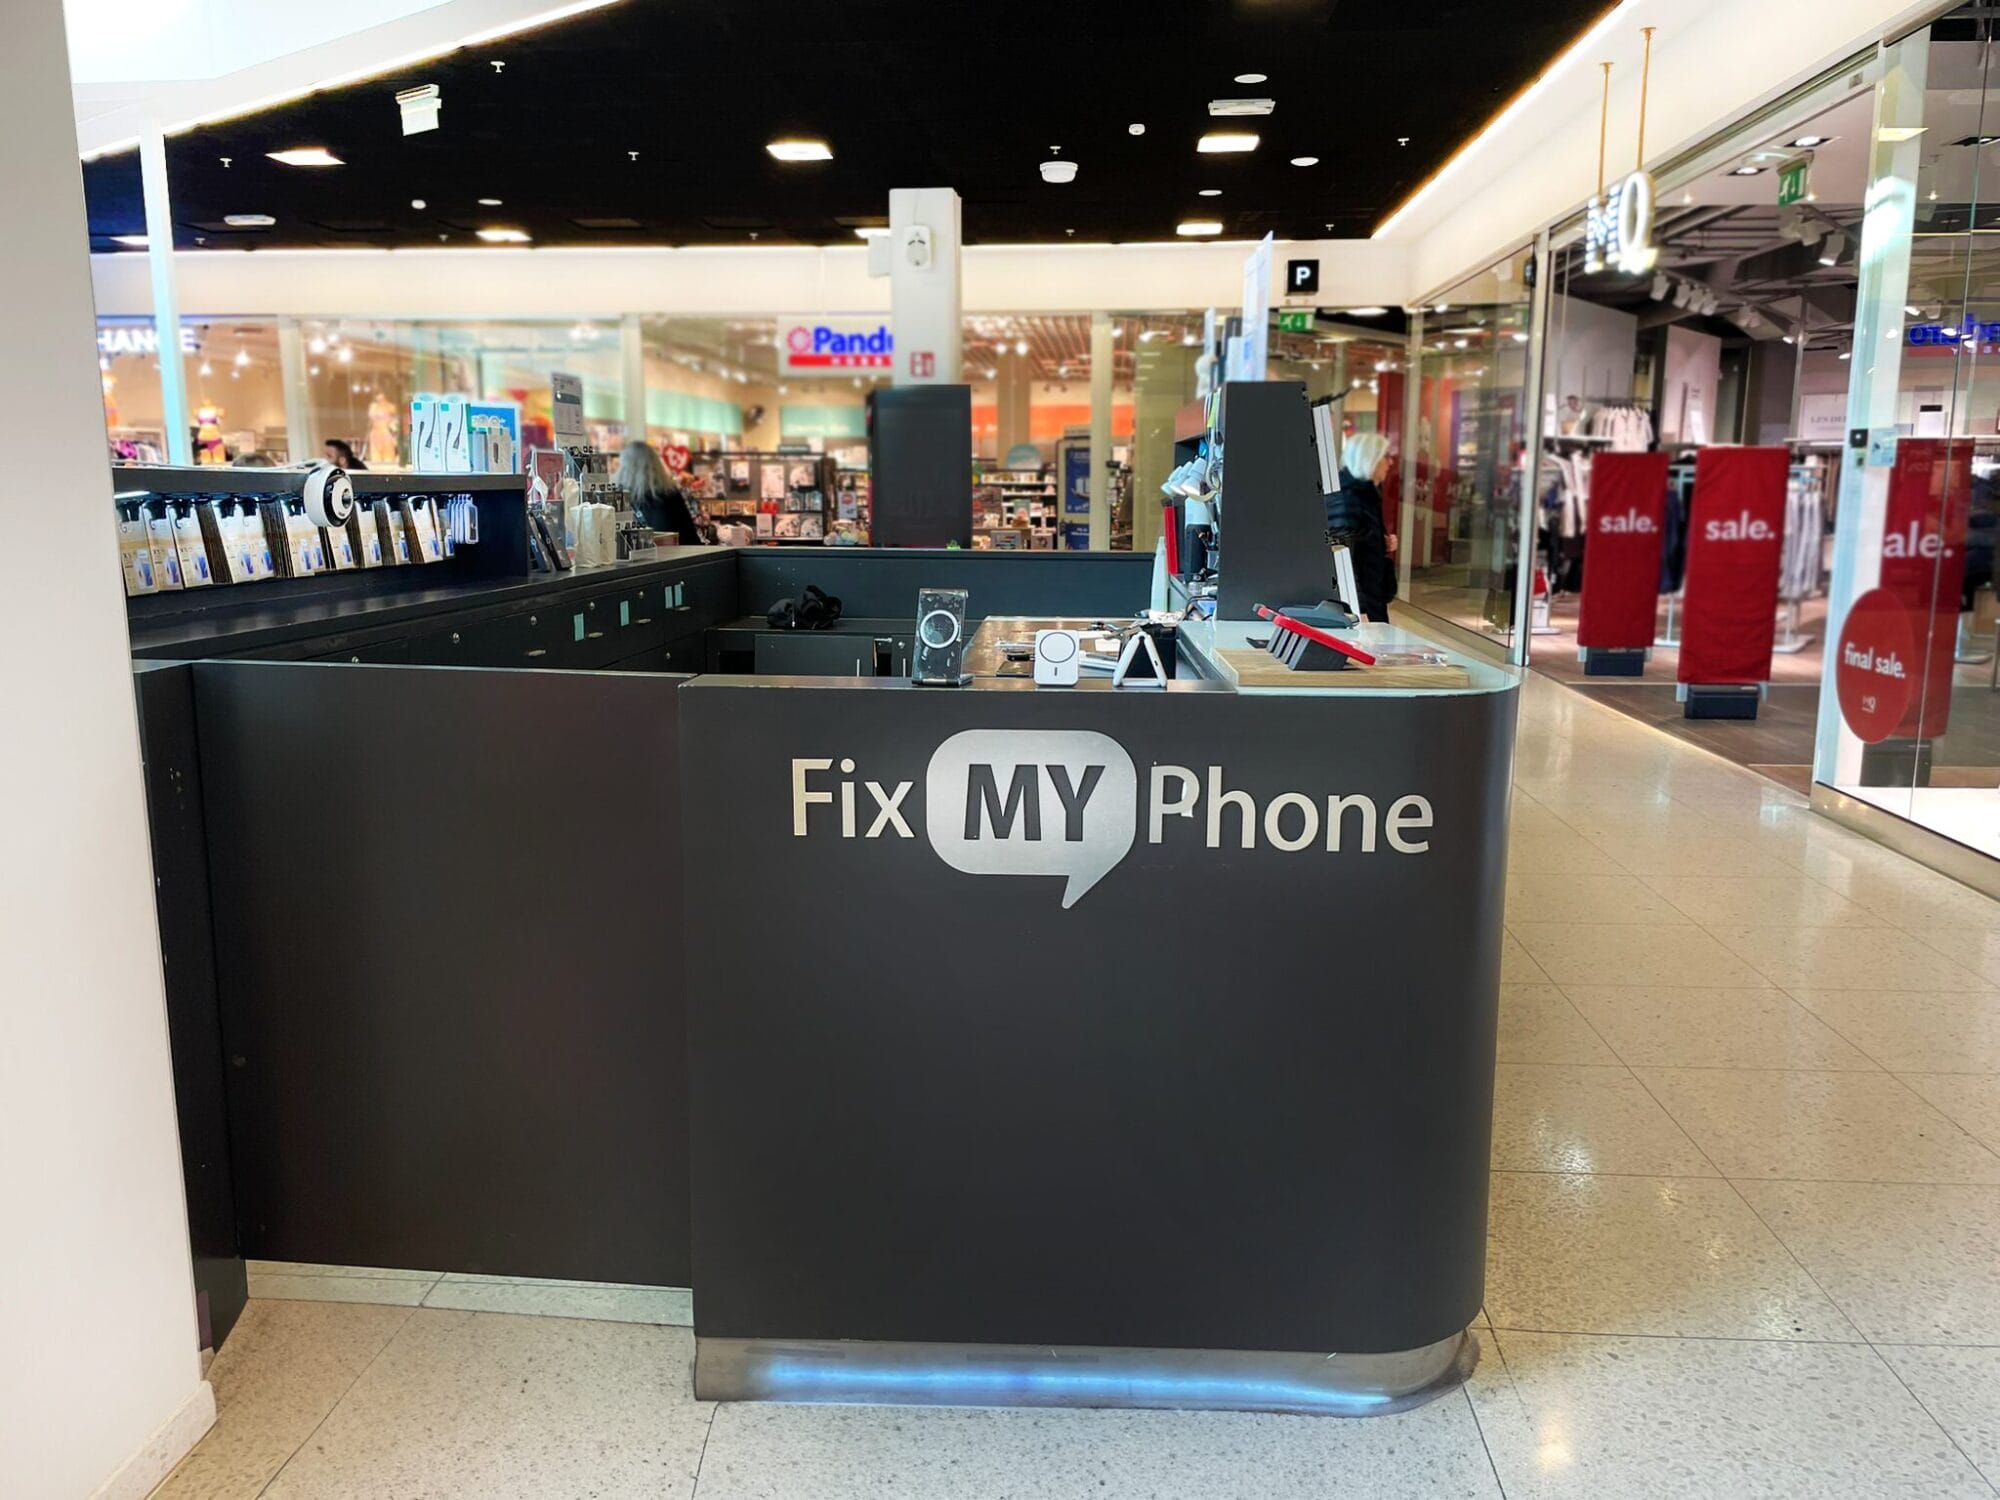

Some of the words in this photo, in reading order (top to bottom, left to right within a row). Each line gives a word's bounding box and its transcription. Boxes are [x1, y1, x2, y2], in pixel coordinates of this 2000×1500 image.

[1296, 266, 1311, 285] P
[1599, 508, 1659, 533] sale.
[1705, 510, 1776, 540] sale.
[1882, 519, 1954, 558] ale.
[1844, 641, 1874, 670] final
[1875, 652, 1906, 679] sale.
[792, 758, 915, 838] Fix
[963, 764, 1106, 842] MY
[1149, 765, 1434, 854] Phone
